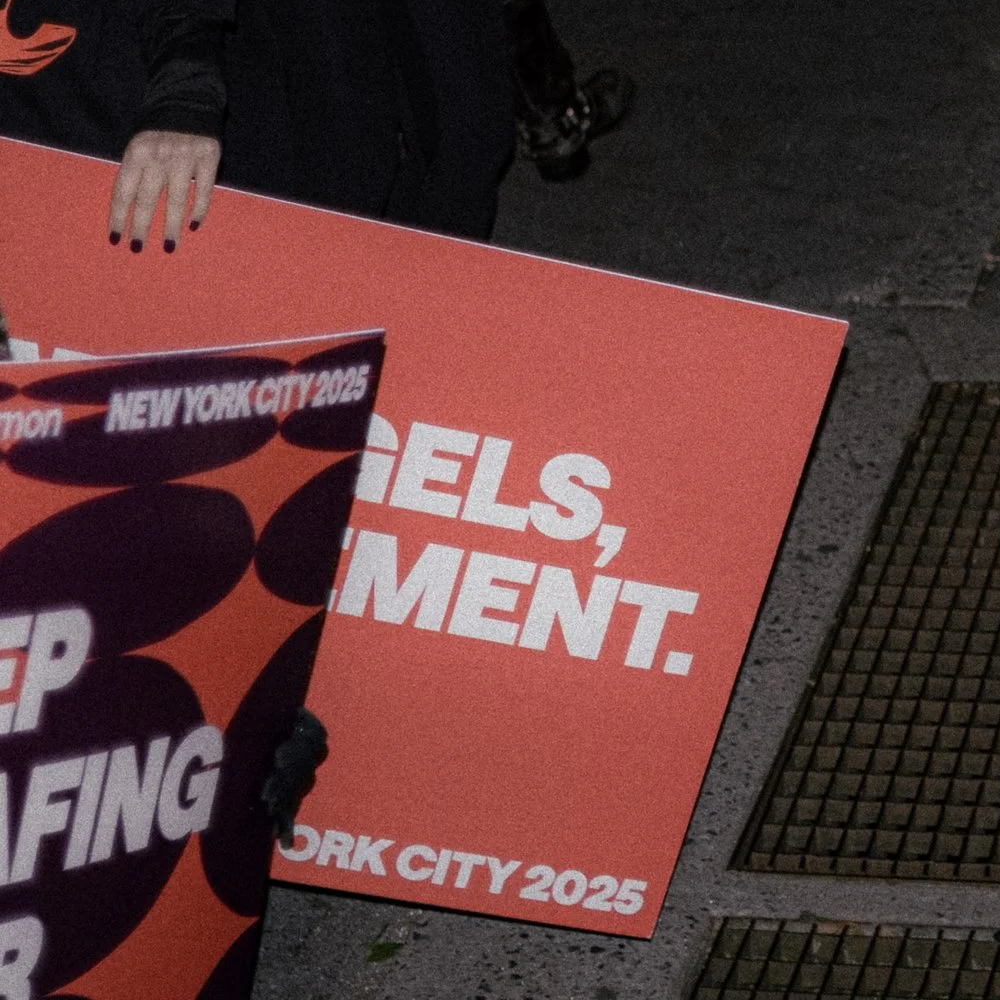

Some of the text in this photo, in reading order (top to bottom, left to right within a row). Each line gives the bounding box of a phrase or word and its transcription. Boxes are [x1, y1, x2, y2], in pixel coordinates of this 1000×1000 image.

[104, 364, 371, 433] NEW YORK CITY 2025
[326, 527, 700, 677] MENT.
[0, 725, 225, 886] FING
[396, 844, 523, 895] CITY
[519, 863, 649, 917] 2025
